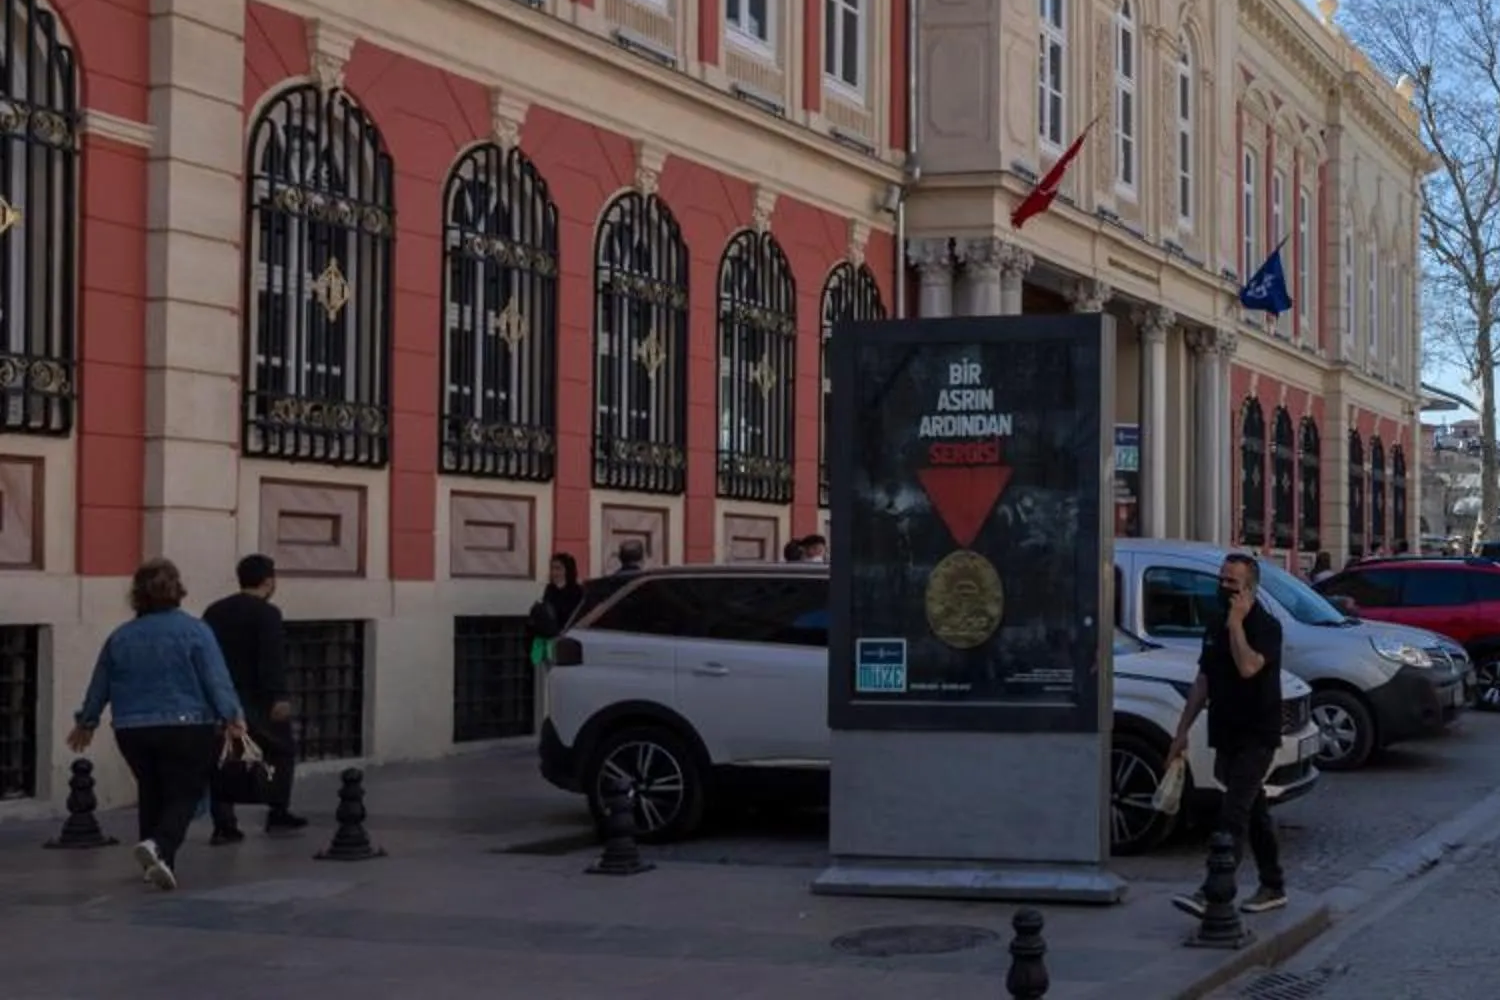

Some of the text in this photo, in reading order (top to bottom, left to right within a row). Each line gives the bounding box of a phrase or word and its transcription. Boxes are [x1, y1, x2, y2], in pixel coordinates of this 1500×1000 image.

[949, 358, 982, 385] BİR
[937, 389, 994, 411] ASRIN
[919, 414, 1013, 437] ARDINDAN
